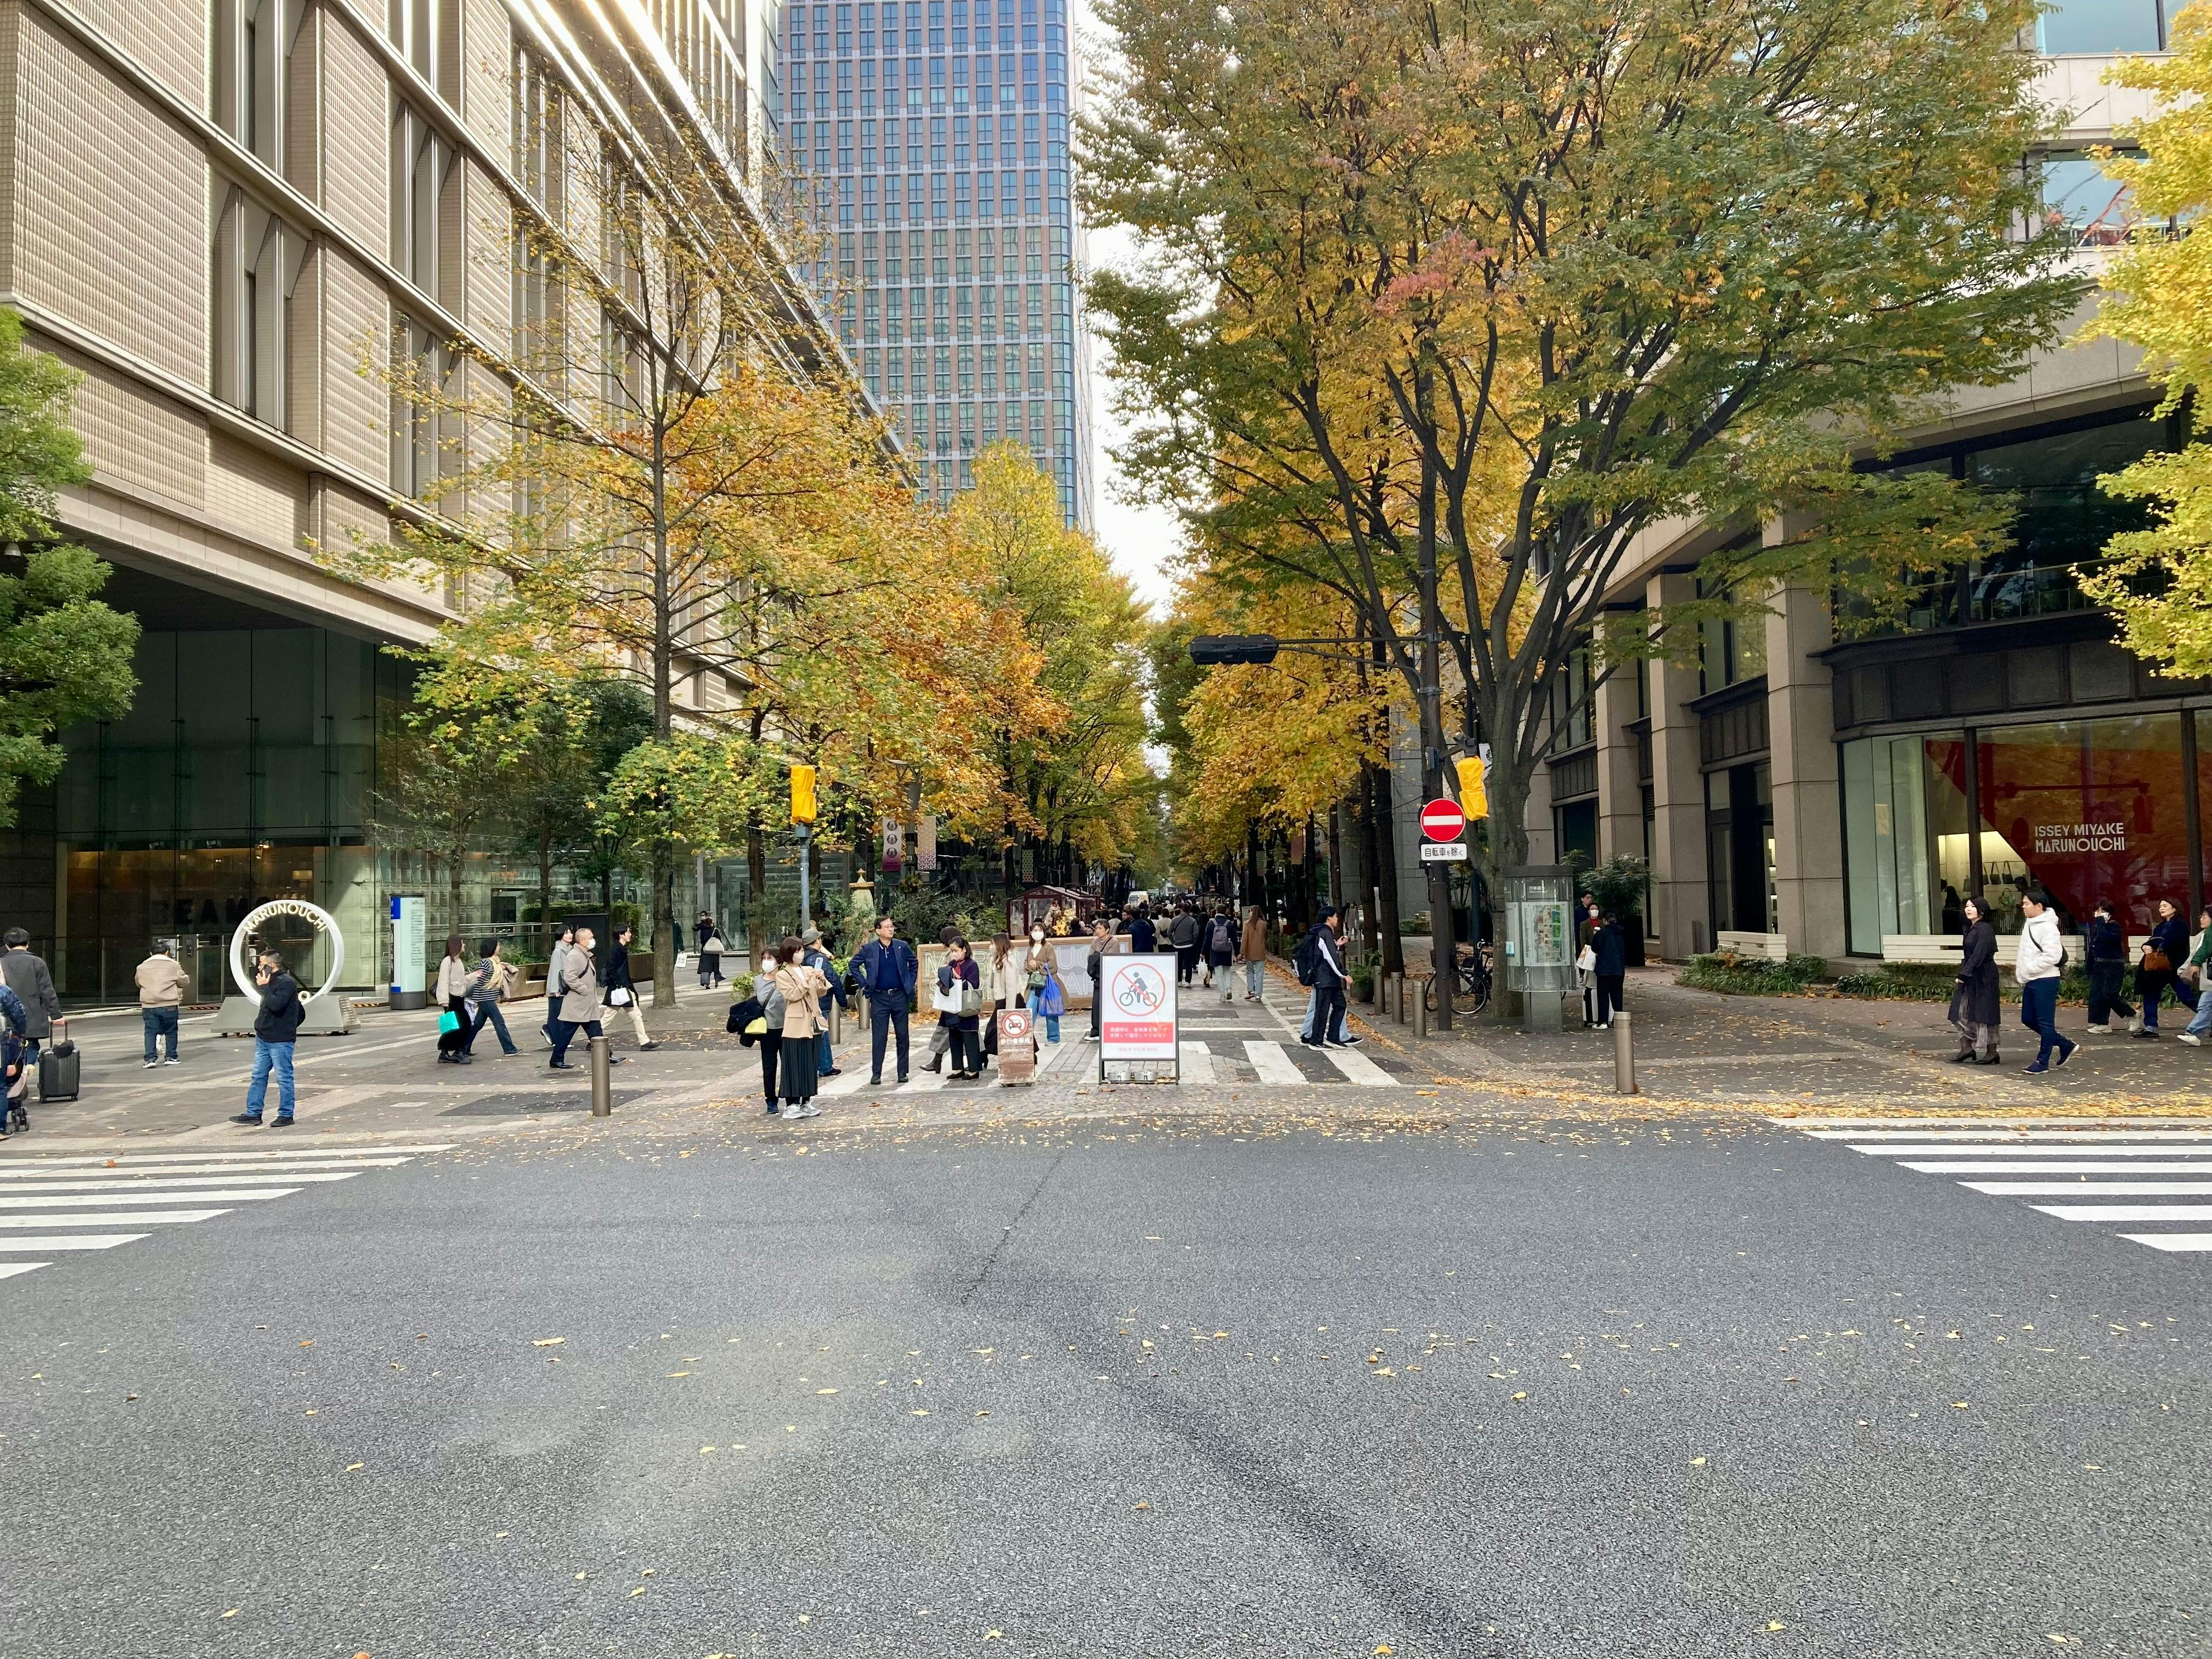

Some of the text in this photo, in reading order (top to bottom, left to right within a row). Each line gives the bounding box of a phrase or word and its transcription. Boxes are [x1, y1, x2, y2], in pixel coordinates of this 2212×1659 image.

[2035, 823, 2124, 837] ISSEY MIYAKE
[1425, 847, 1463, 857] 自転車を除く
[2035, 837, 2125, 853] MARUNOUCHI
[242, 903, 329, 934] MARUNOUCHI
